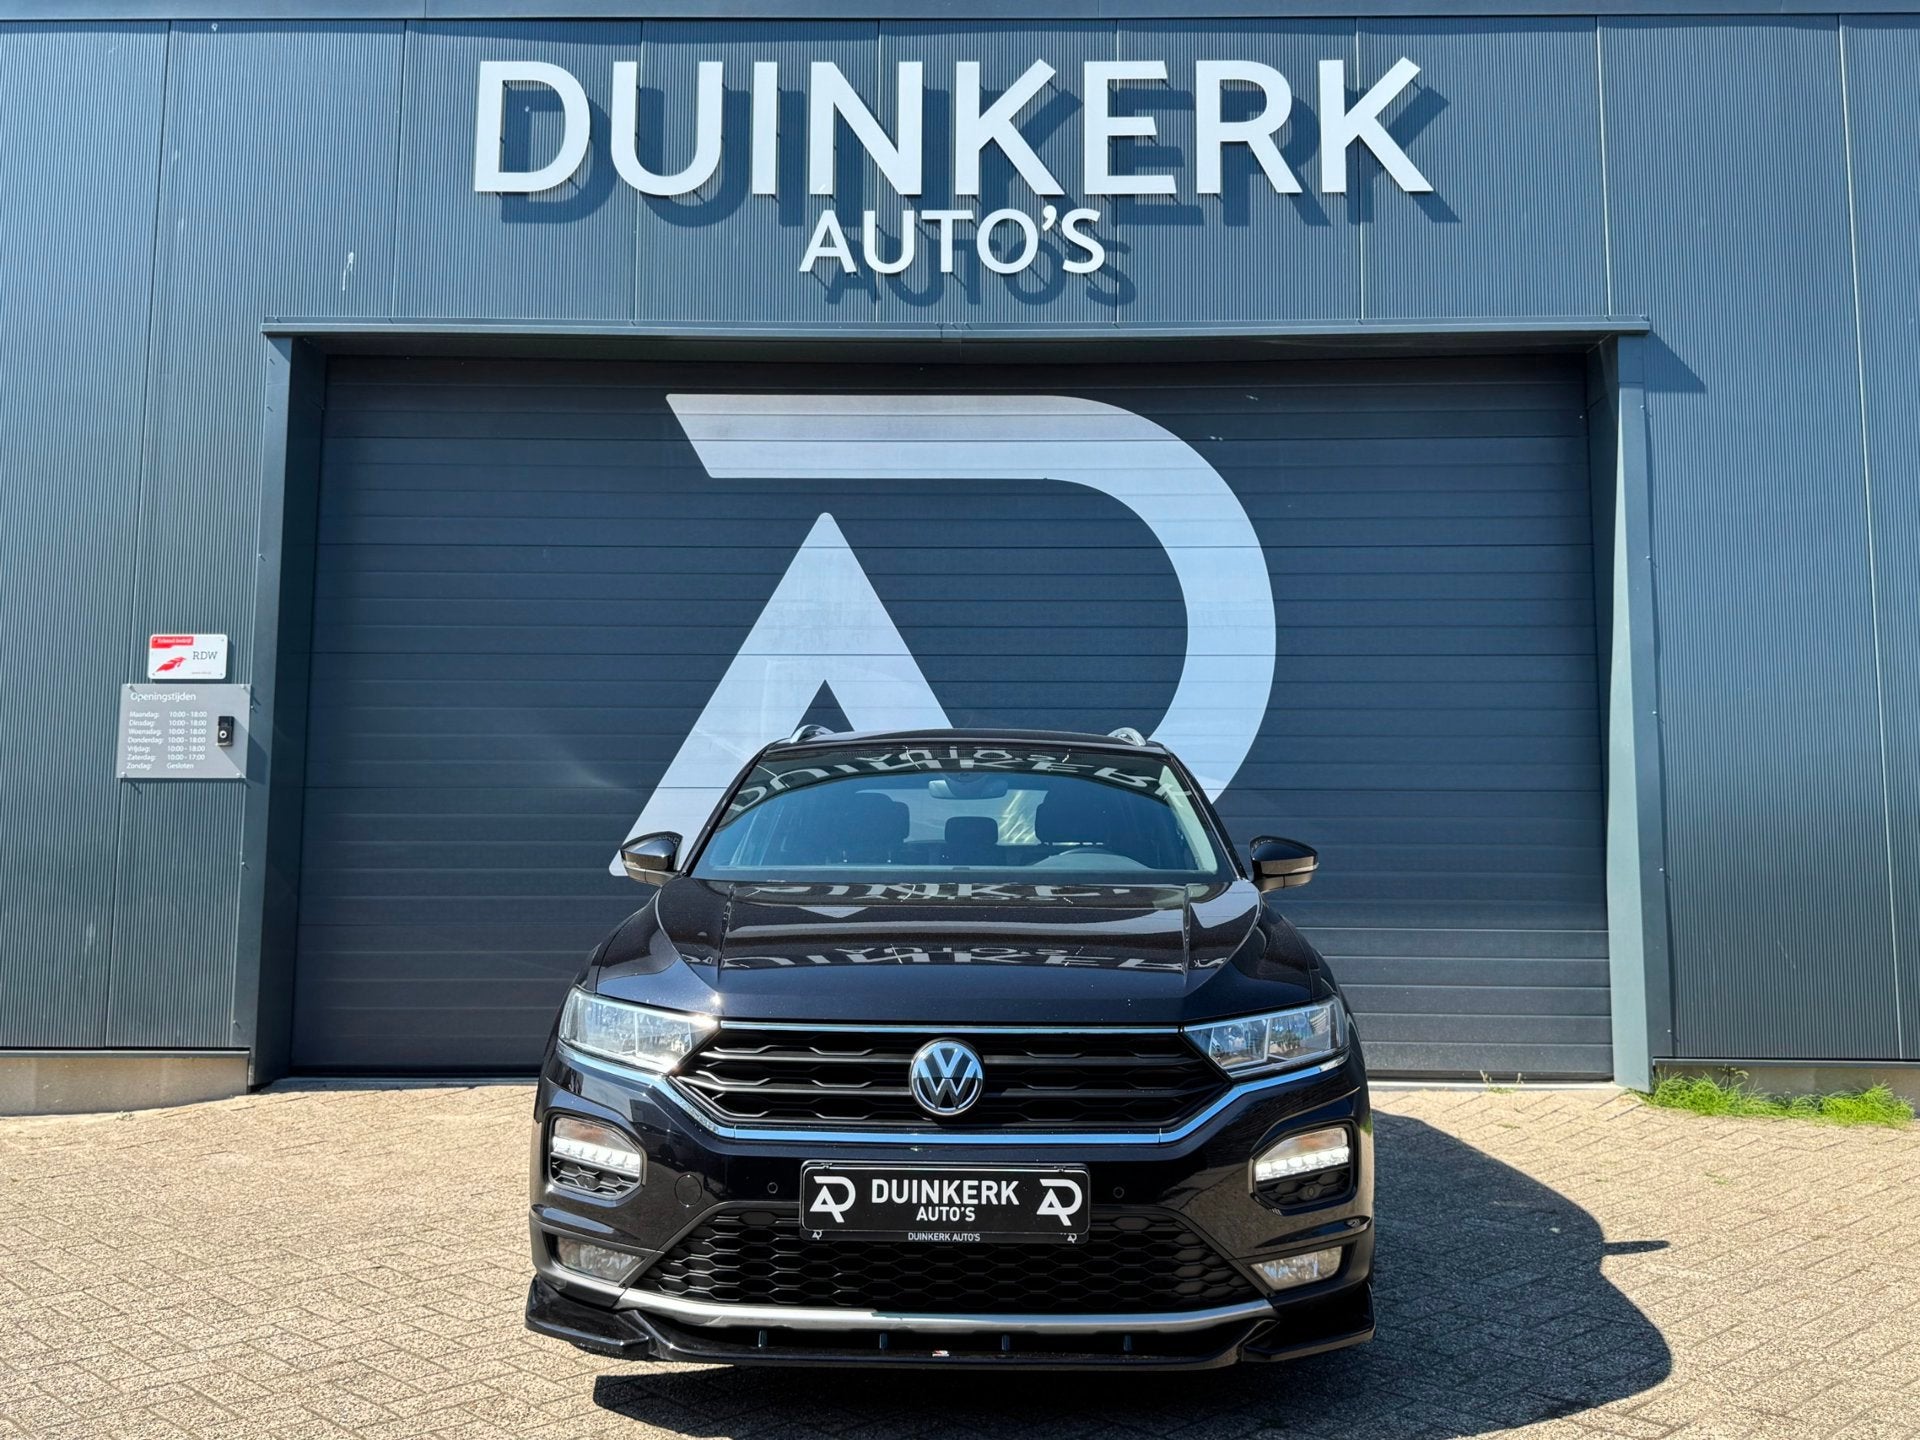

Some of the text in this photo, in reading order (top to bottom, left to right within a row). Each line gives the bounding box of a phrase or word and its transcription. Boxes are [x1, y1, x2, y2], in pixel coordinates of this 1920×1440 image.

[473, 57, 1434, 197] DUINKERK
[799, 206, 1106, 276] AUTO'S
[192, 651, 218, 660] RDW
[130, 692, 196, 702] Openingstijden
[871, 1178, 1021, 1206] DUINKERK
[916, 1206, 976, 1222] AUTO'S
[908, 1232, 951, 1241] DUINKERK
[952, 1233, 980, 1242] AUTO'S
